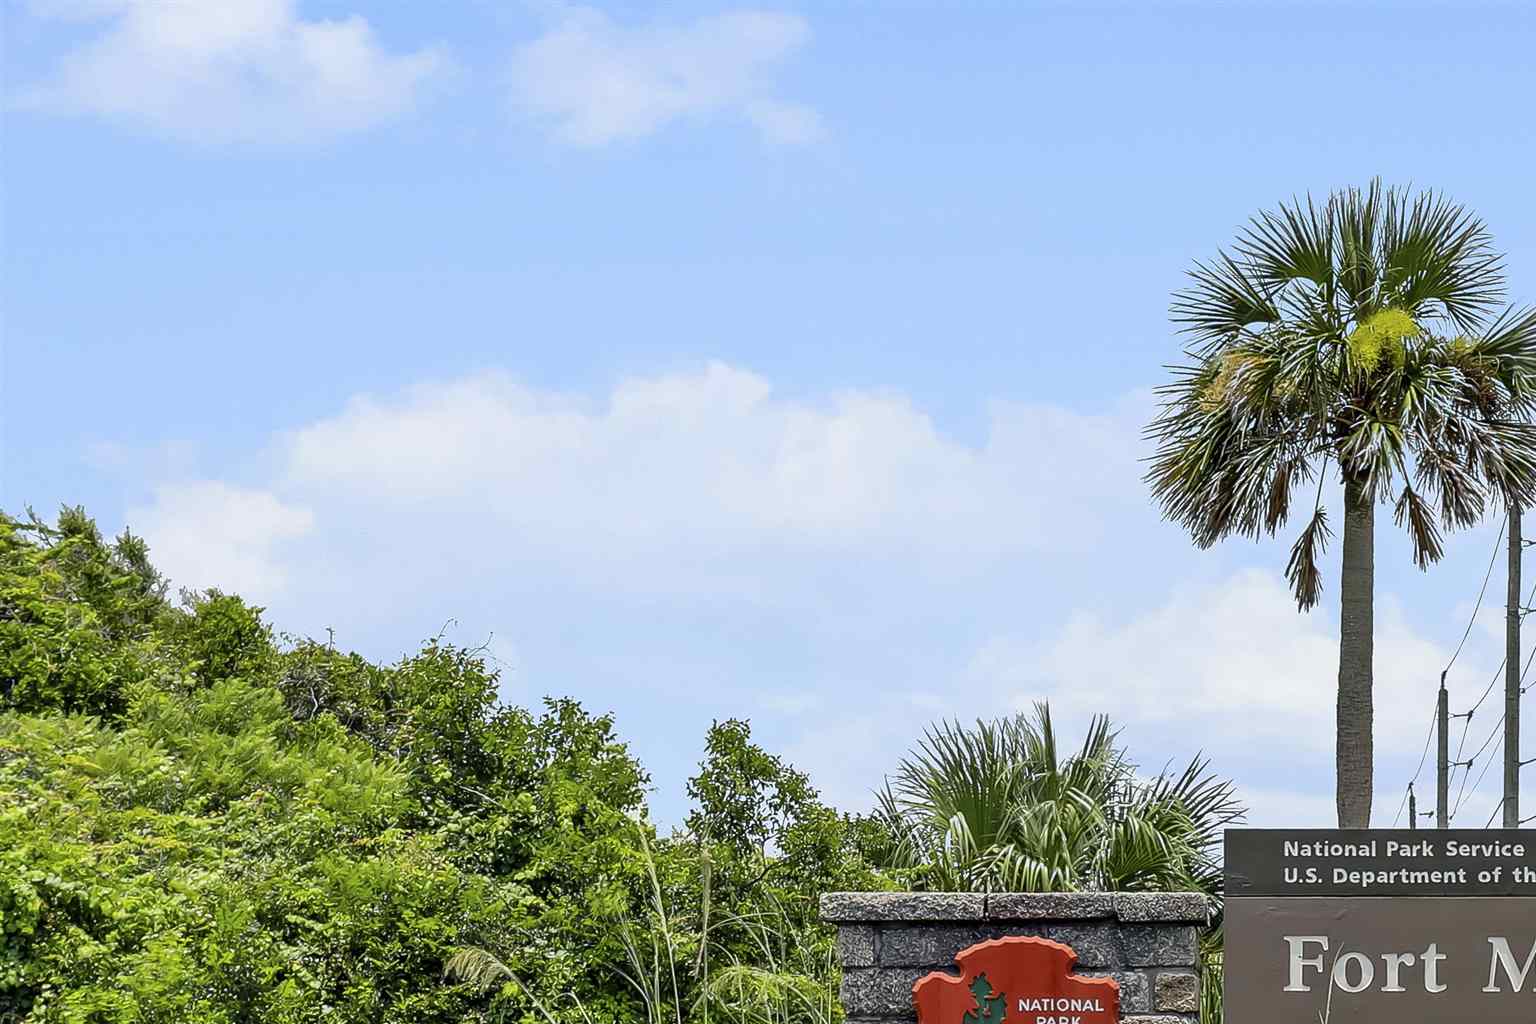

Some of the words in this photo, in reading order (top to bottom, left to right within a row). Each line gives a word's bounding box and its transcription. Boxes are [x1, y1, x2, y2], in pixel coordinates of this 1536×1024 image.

[1284, 840, 1377, 857] National
[1386, 840, 1434, 857] Park
[1445, 840, 1525, 857] Service
[1284, 867, 1323, 884] U.S.
[1332, 867, 1467, 887] Department
[1477, 866, 1502, 883] of
[1283, 935, 1448, 993] Fort
[1018, 998, 1105, 1012] NATIONAL
